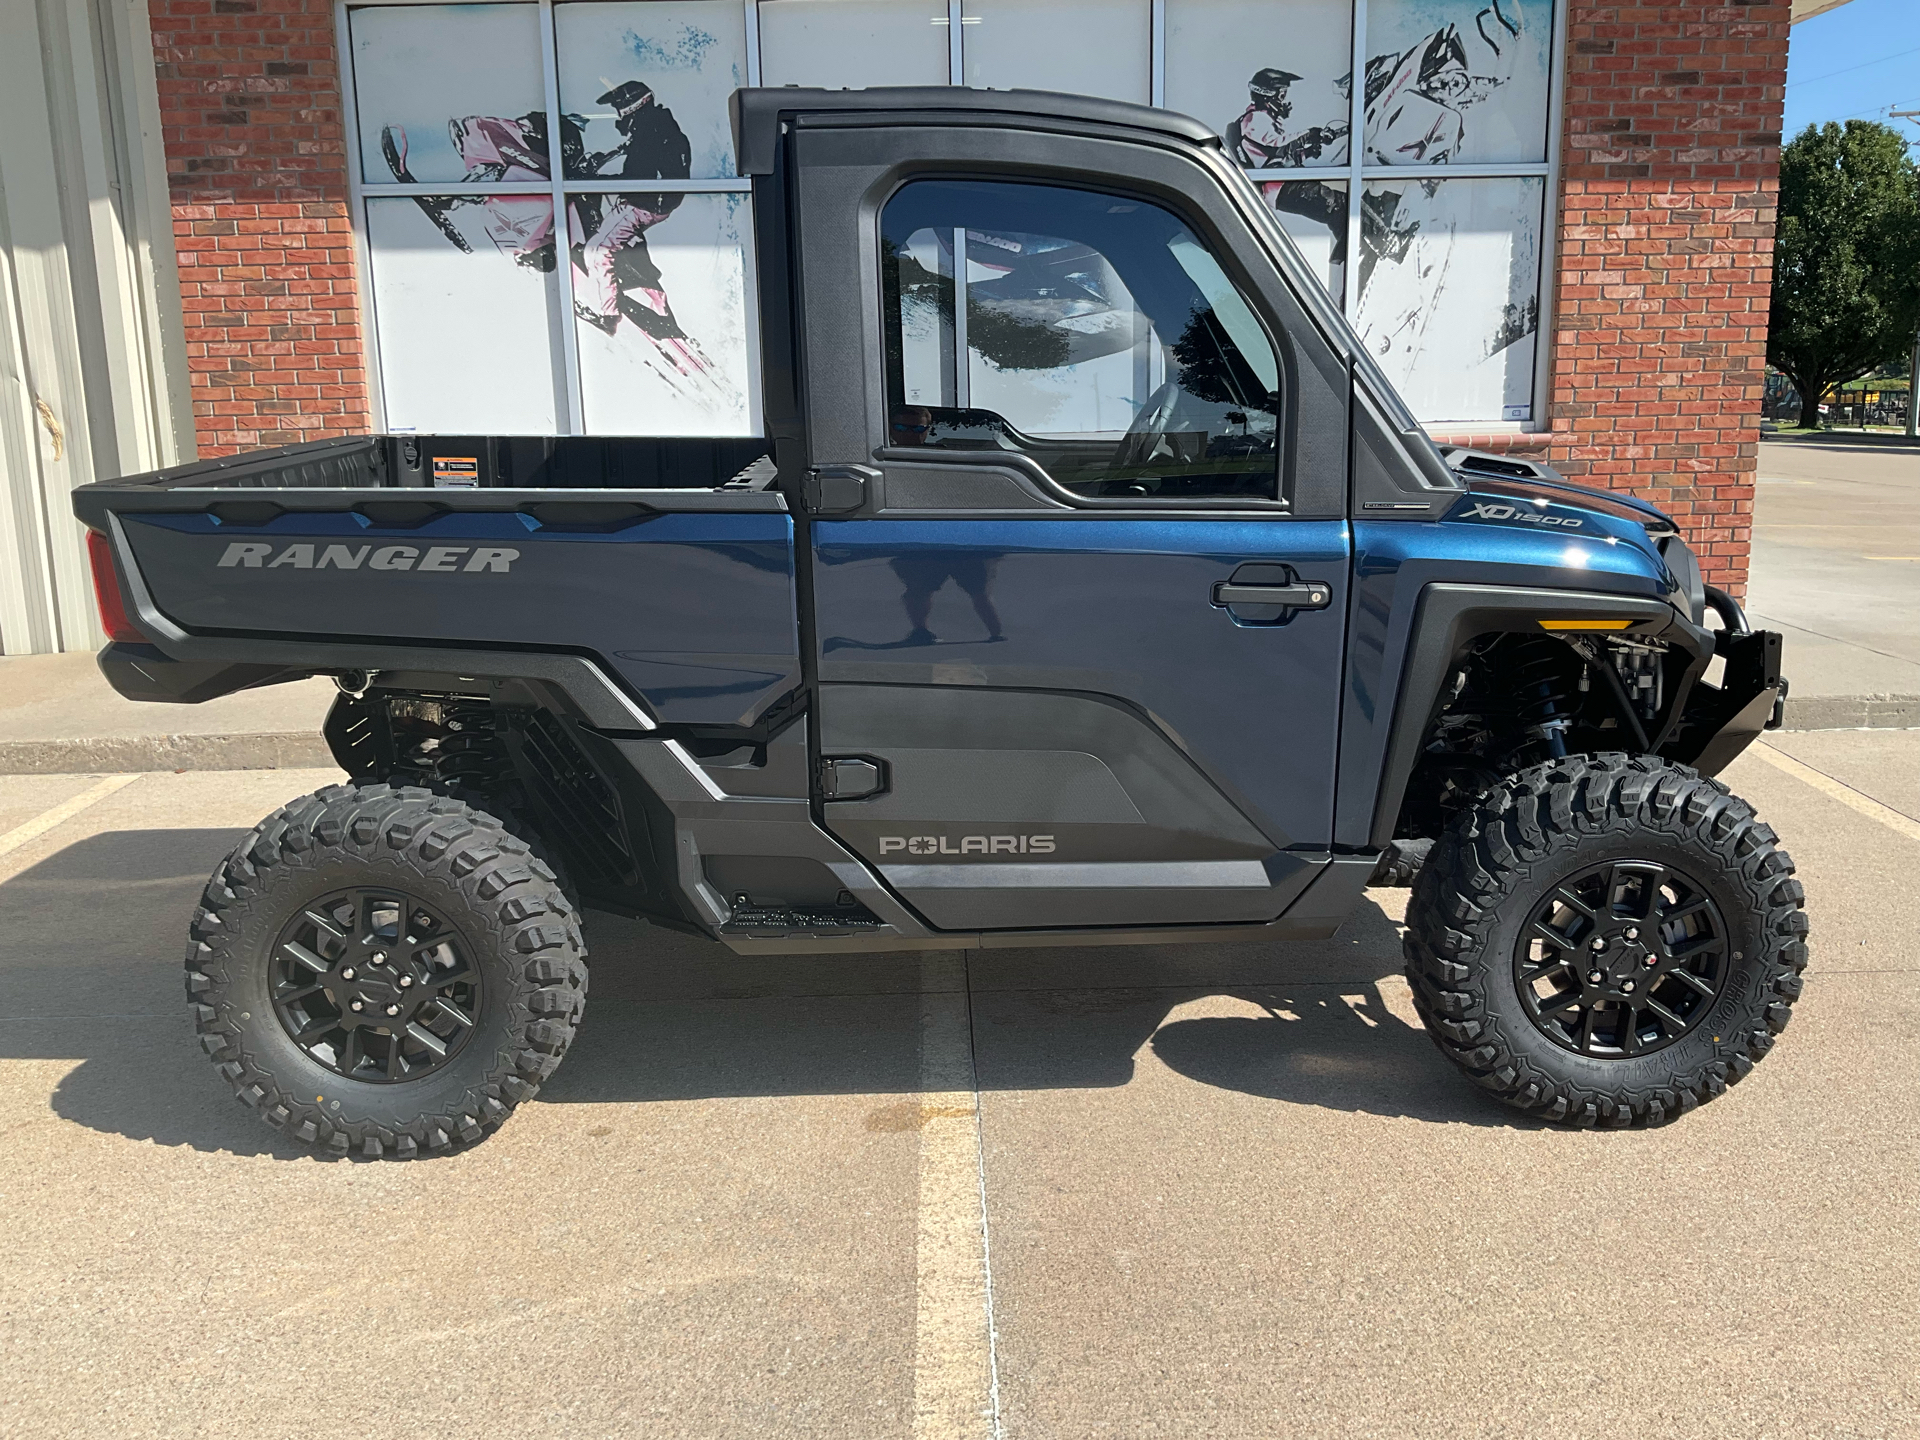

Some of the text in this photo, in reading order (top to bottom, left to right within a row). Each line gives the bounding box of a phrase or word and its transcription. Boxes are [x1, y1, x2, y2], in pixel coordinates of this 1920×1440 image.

[1459, 503, 1583, 527] XD 1500
[217, 543, 520, 573] RANGER
[879, 835, 1056, 855] POLARIS
[1698, 968, 1751, 1047] CROSS
